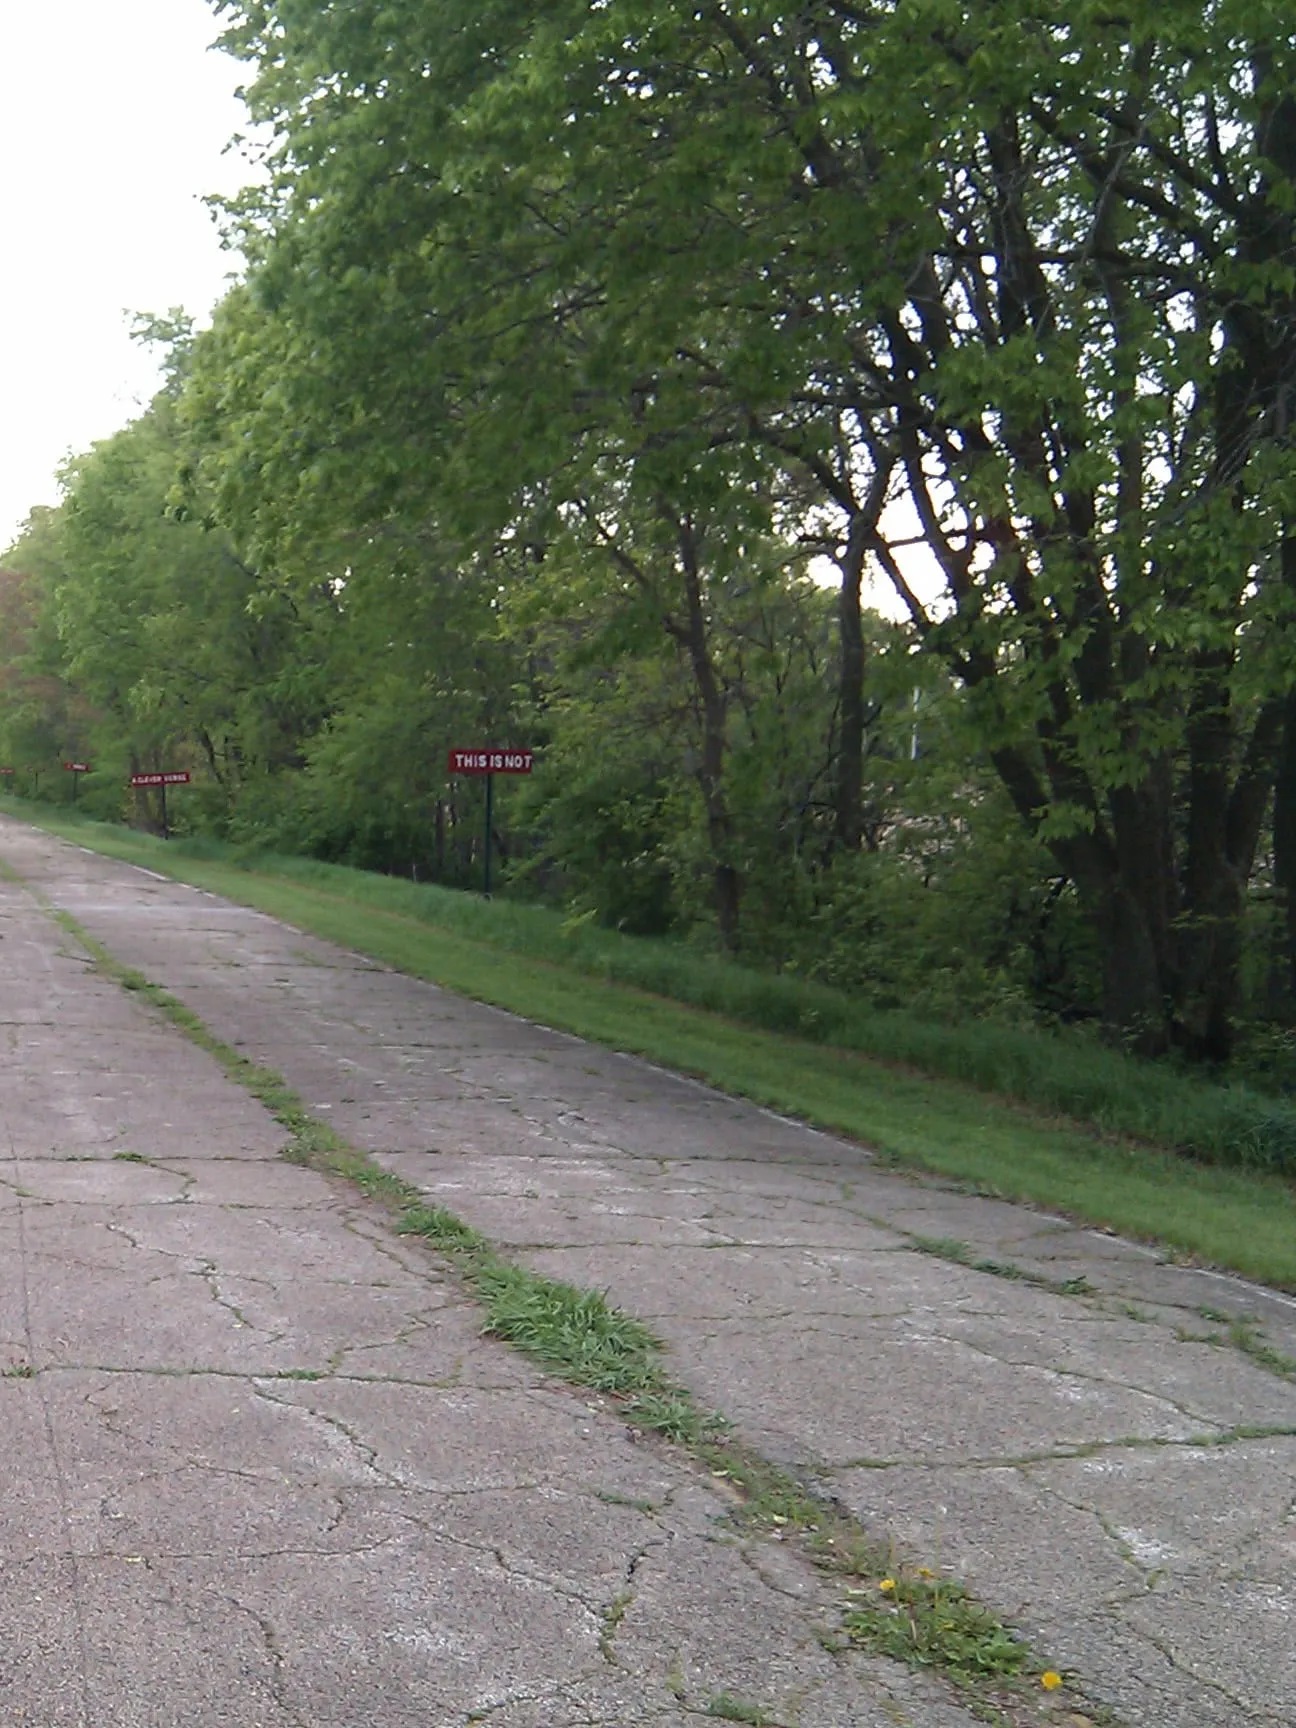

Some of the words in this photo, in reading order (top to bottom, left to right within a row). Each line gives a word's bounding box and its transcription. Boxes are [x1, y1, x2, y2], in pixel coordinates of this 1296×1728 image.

[455, 753, 487, 768] THIS
[490, 754, 503, 769] IS
[504, 755, 533, 769] NOT
